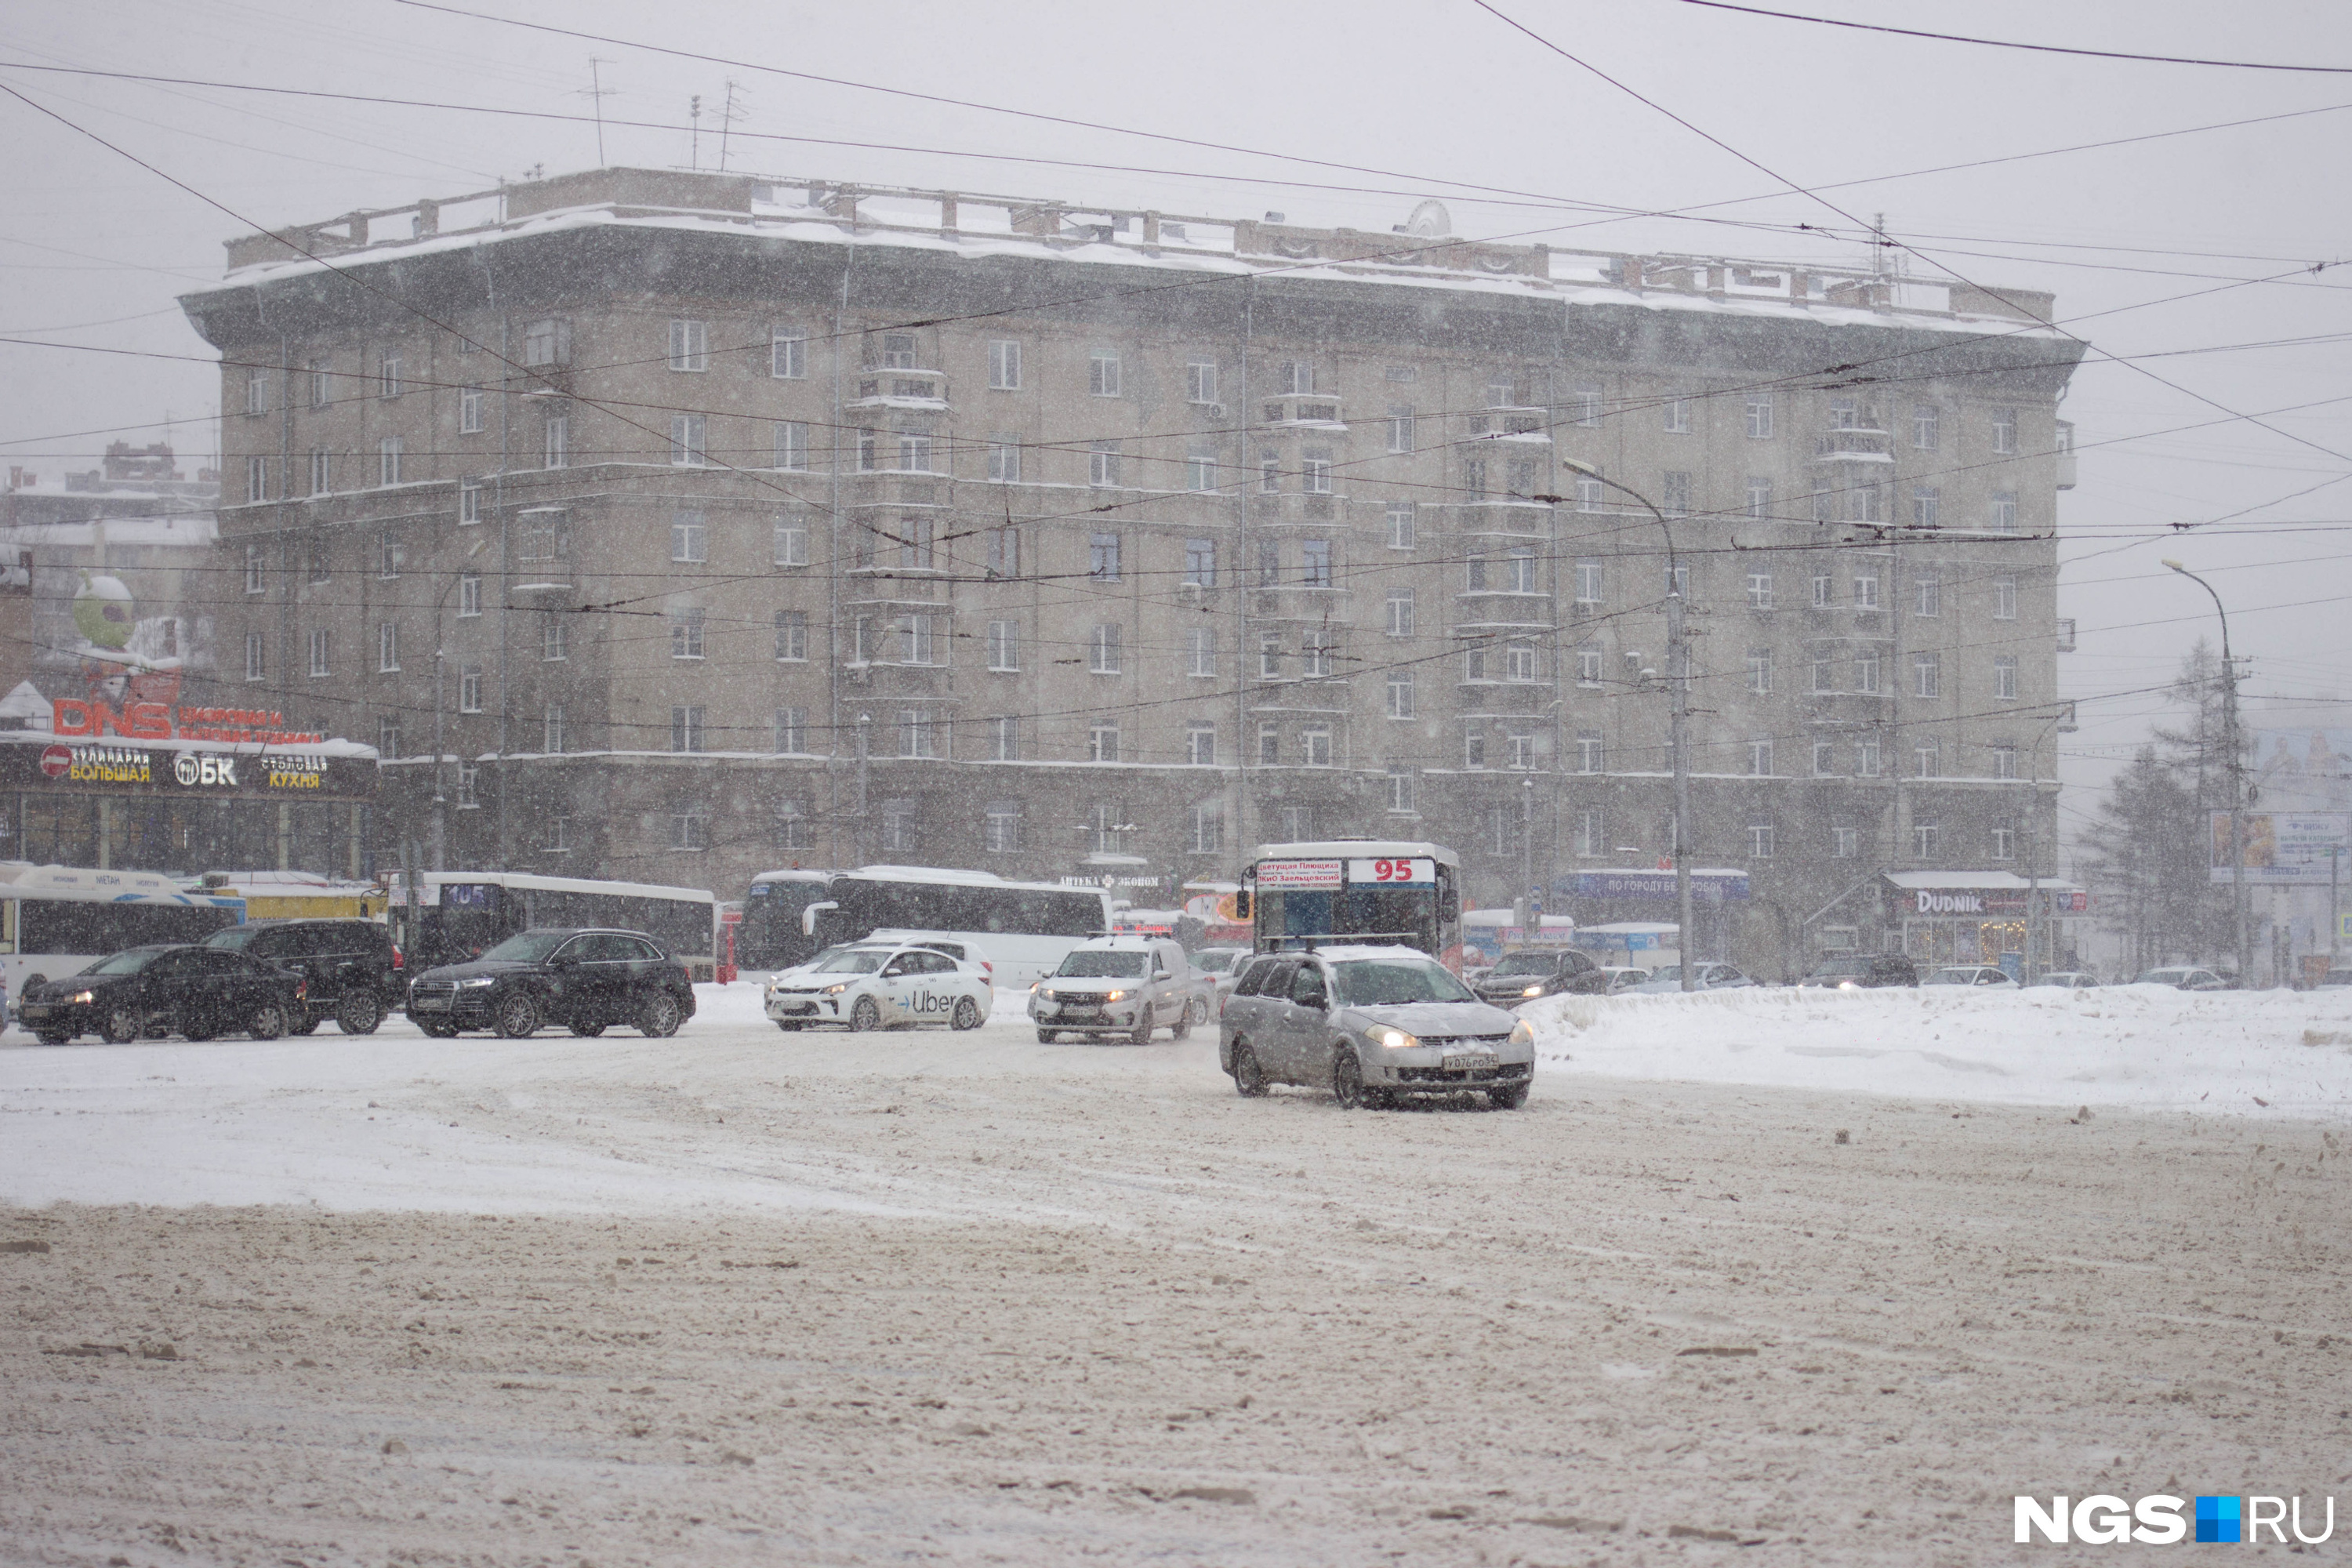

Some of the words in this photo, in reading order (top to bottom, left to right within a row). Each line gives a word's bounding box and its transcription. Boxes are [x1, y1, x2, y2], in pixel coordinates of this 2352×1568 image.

[53, 698, 172, 739] DNS
[179, 706, 267, 724] ЦИФРОВАЯ
[179, 726, 251, 742] БЫТОВАЯ
[255, 730, 321, 745] ТЕХНИКА
[72, 750, 150, 765] КУЛИНАРИЯ
[261, 759, 327, 772] СТОЛОВАЯ
[71, 764, 150, 782] БОЛЬШАЯ
[270, 771, 319, 788] КУХНЯ
[1279, 874, 1340, 883] Заельцовский
[1374, 860, 1413, 881] 95
[96, 875, 121, 886] МЕТАН
[1059, 877, 1099, 887] АПТЕКА
[1117, 877, 1160, 887] ЭКОНОМ
[1624, 880, 1663, 893] ГОРОДУ
[449, 885, 485, 903] 105
[913, 990, 957, 1013] Uber
